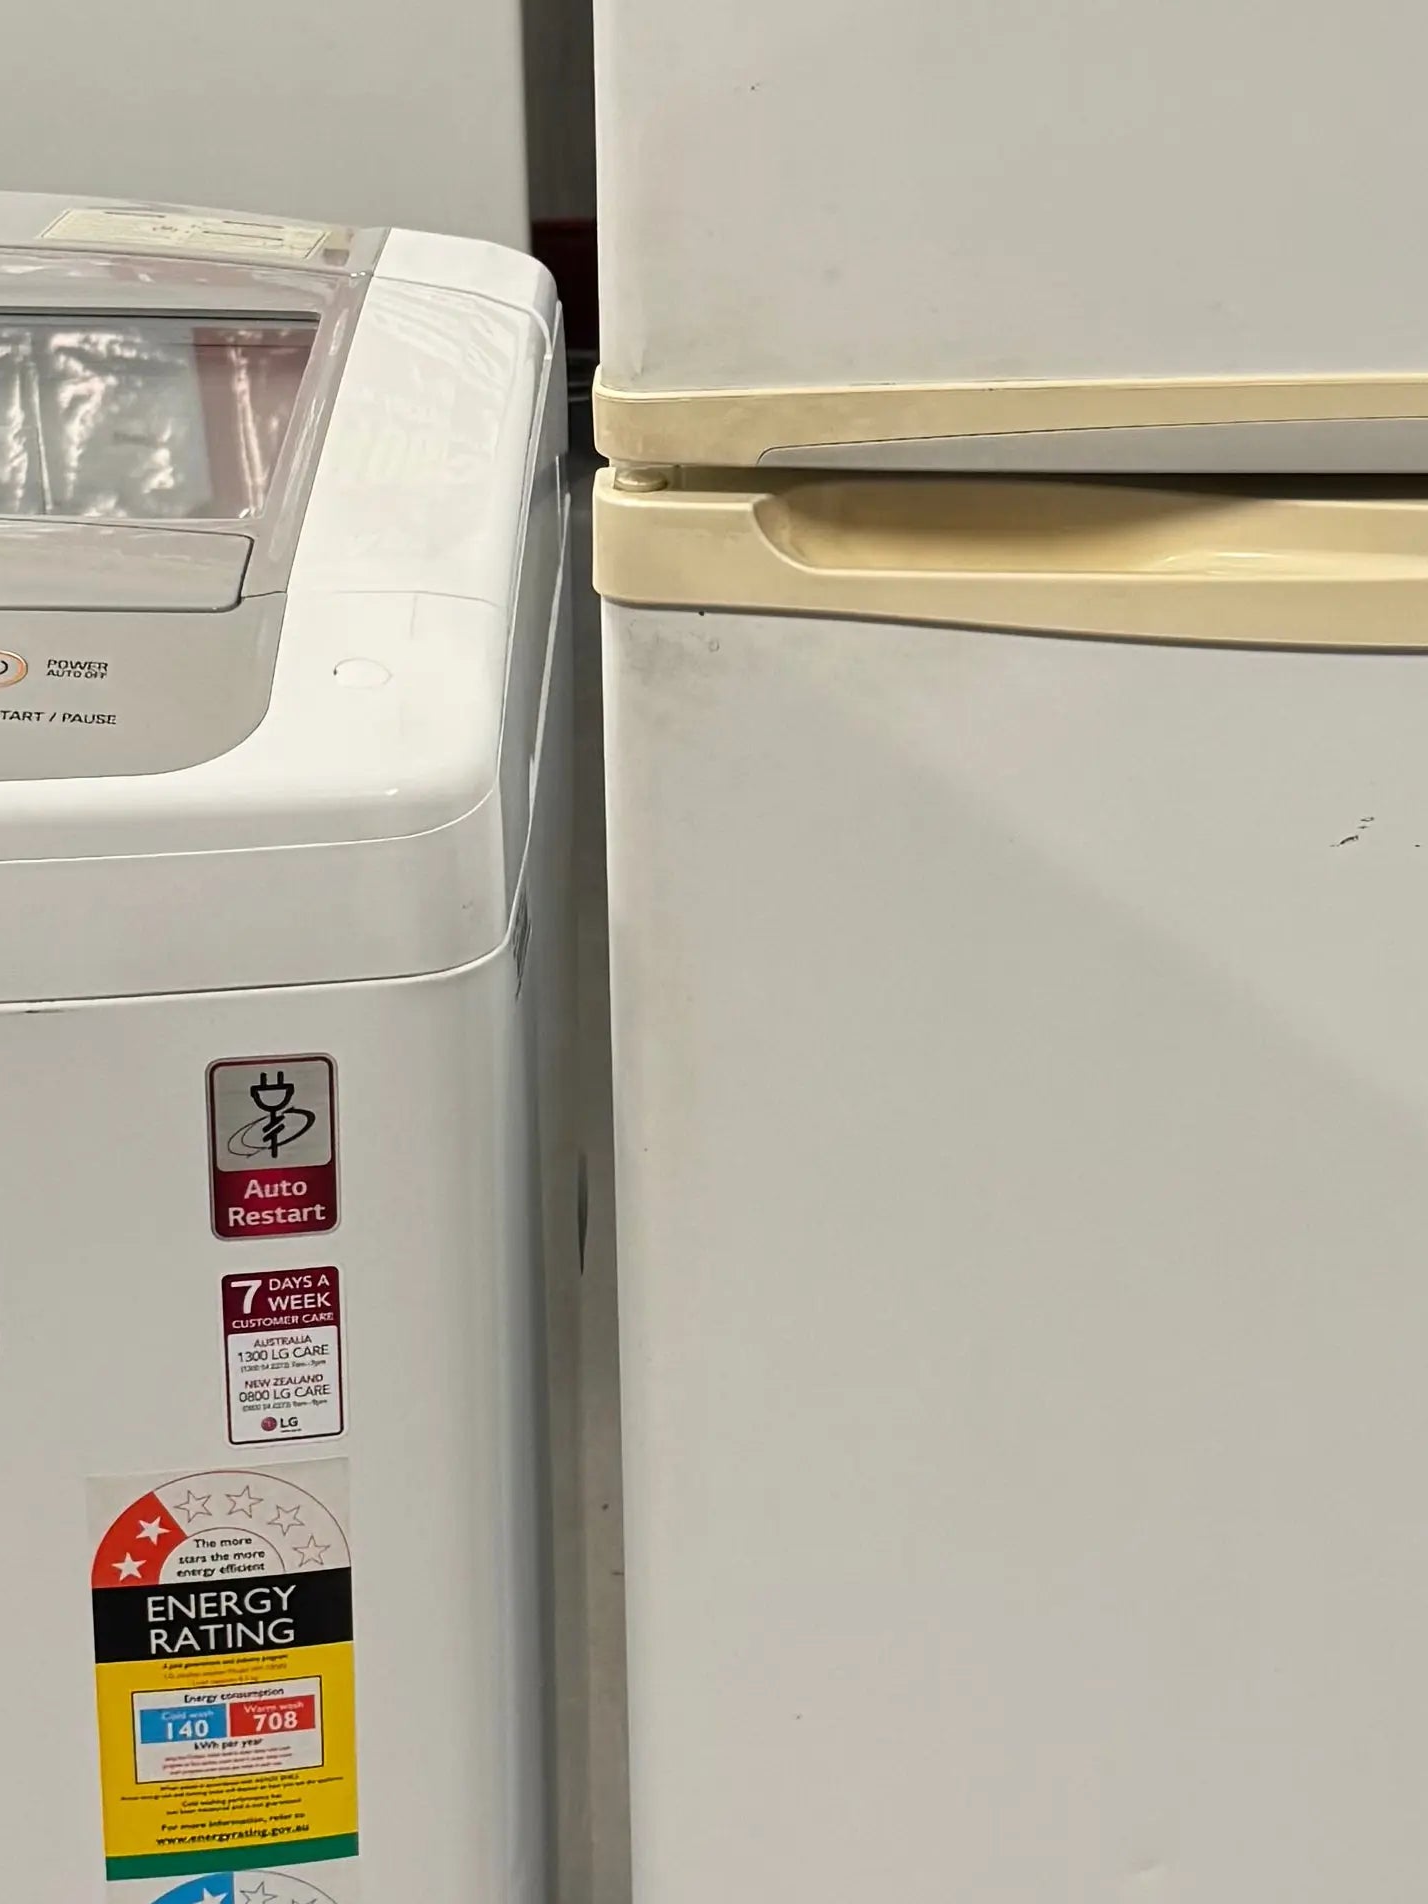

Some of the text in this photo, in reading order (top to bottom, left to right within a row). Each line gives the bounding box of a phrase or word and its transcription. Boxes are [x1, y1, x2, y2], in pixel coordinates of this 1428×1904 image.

[48, 659, 108, 671] POWER
[47, 670, 81, 678] AUTO
[62, 713, 116, 724] PAUSE
[244, 1179, 307, 1199] Auto
[228, 1204, 325, 1226] Restart
[230, 1274, 329, 1314] 7 DAYS A
[268, 1292, 331, 1311] WEEK
[232, 1313, 333, 1329] CUSTOMER CARE
[254, 1335, 312, 1347] AUSTRALIA
[237, 1344, 329, 1362] 1300 LG CARE
[245, 1374, 323, 1388] NEW ZEALAND
[239, 1384, 331, 1402] 0800 LG CARE
[280, 1417, 298, 1428] LG
[194, 1537, 252, 1548] The more
[179, 1550, 265, 1564] stars the more
[176, 1563, 265, 1577] energy efficient
[147, 1585, 296, 1622] ENERGY
[149, 1618, 295, 1655] RATING
[185, 1695, 217, 1704] Energy
[253, 1711, 298, 1731] 708
[167, 1720, 208, 1740] 140
